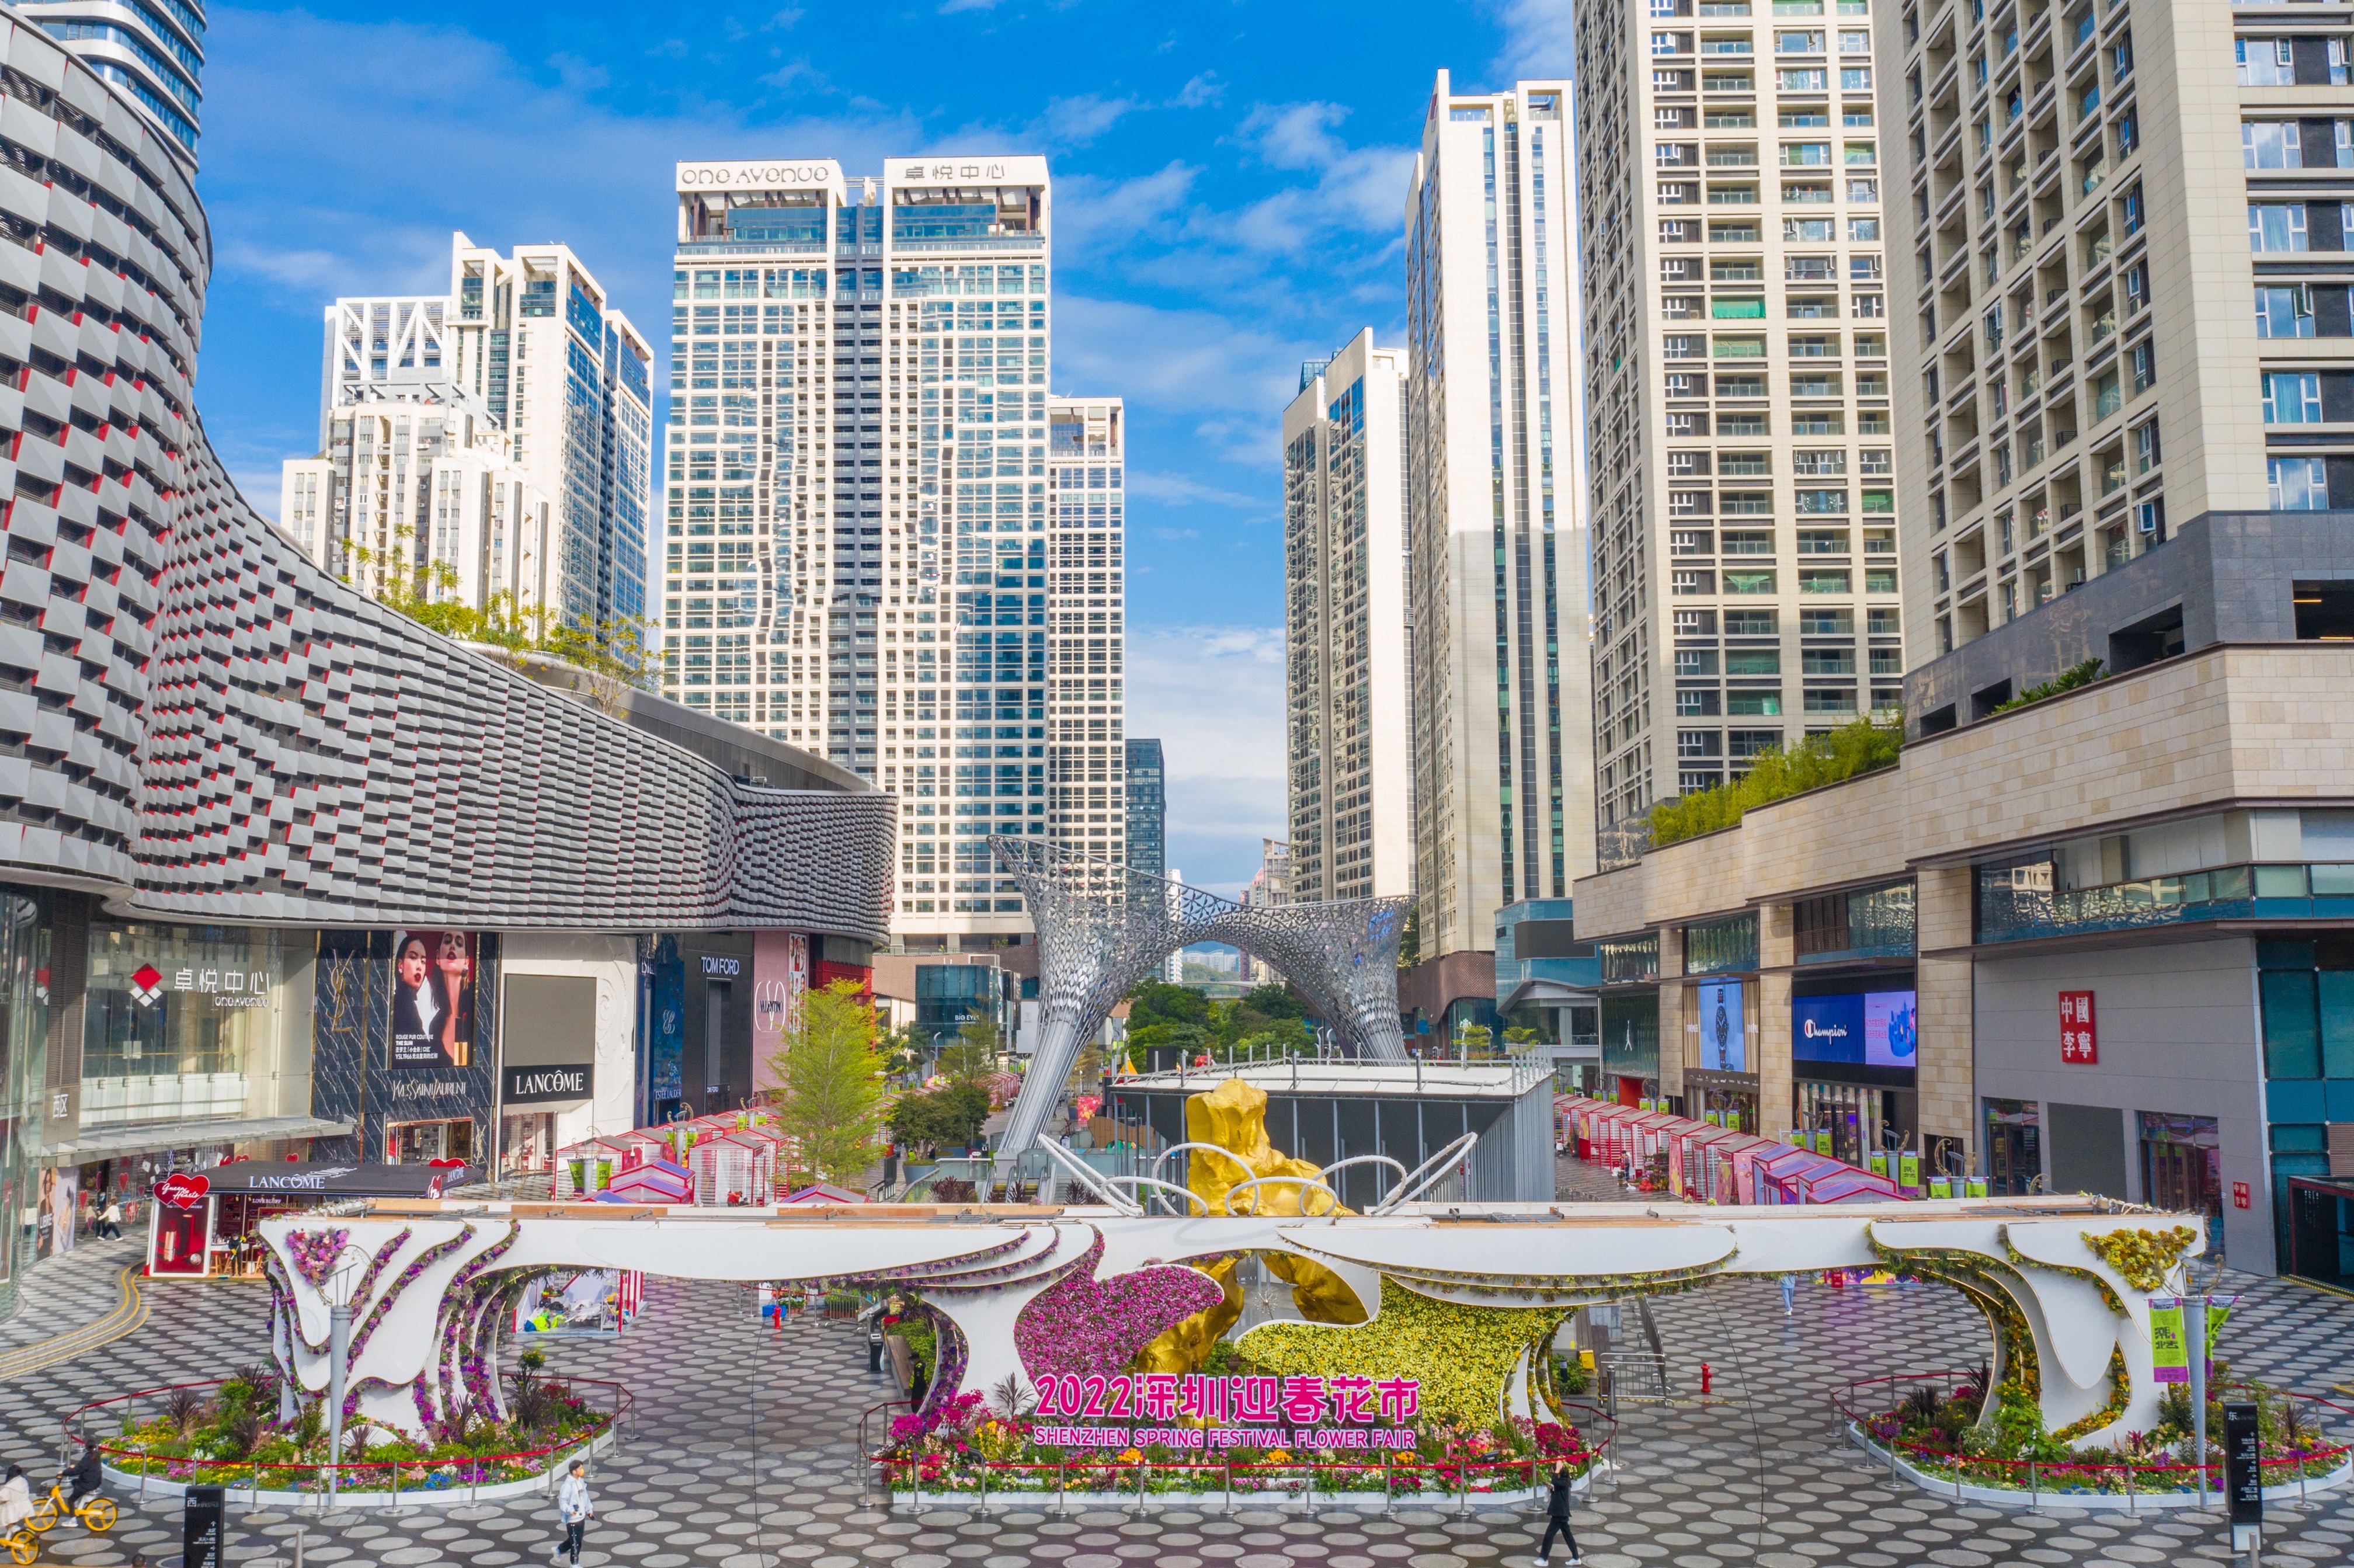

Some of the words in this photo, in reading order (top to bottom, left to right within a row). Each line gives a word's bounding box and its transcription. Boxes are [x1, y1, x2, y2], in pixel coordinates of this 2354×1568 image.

[905, 164, 1005, 180] 卓悦中心
[701, 957, 718, 974] TOM
[719, 958, 740, 975] FORD
[175, 968, 270, 995] 卓悦中心
[1804, 1019, 1848, 1045] Champion
[2063, 1031, 2091, 1058] 李寧
[516, 1070, 583, 1094] LANCÔME
[667, 1089, 681, 1098] LAUDER
[249, 1173, 325, 1190] LANCÔME
[173, 1191, 200, 1200] Hearts
[2228, 1411, 2238, 1421] 东
[1033, 1426, 1129, 1447] SHENZHEN
[1133, 1426, 1204, 1449] SPRING
[1208, 1426, 1291, 1449] FESTIVAL
[1295, 1428, 1369, 1449] FLOWER
[1372, 1429, 1417, 1449] FAIR
[187, 1497, 197, 1507] 西
